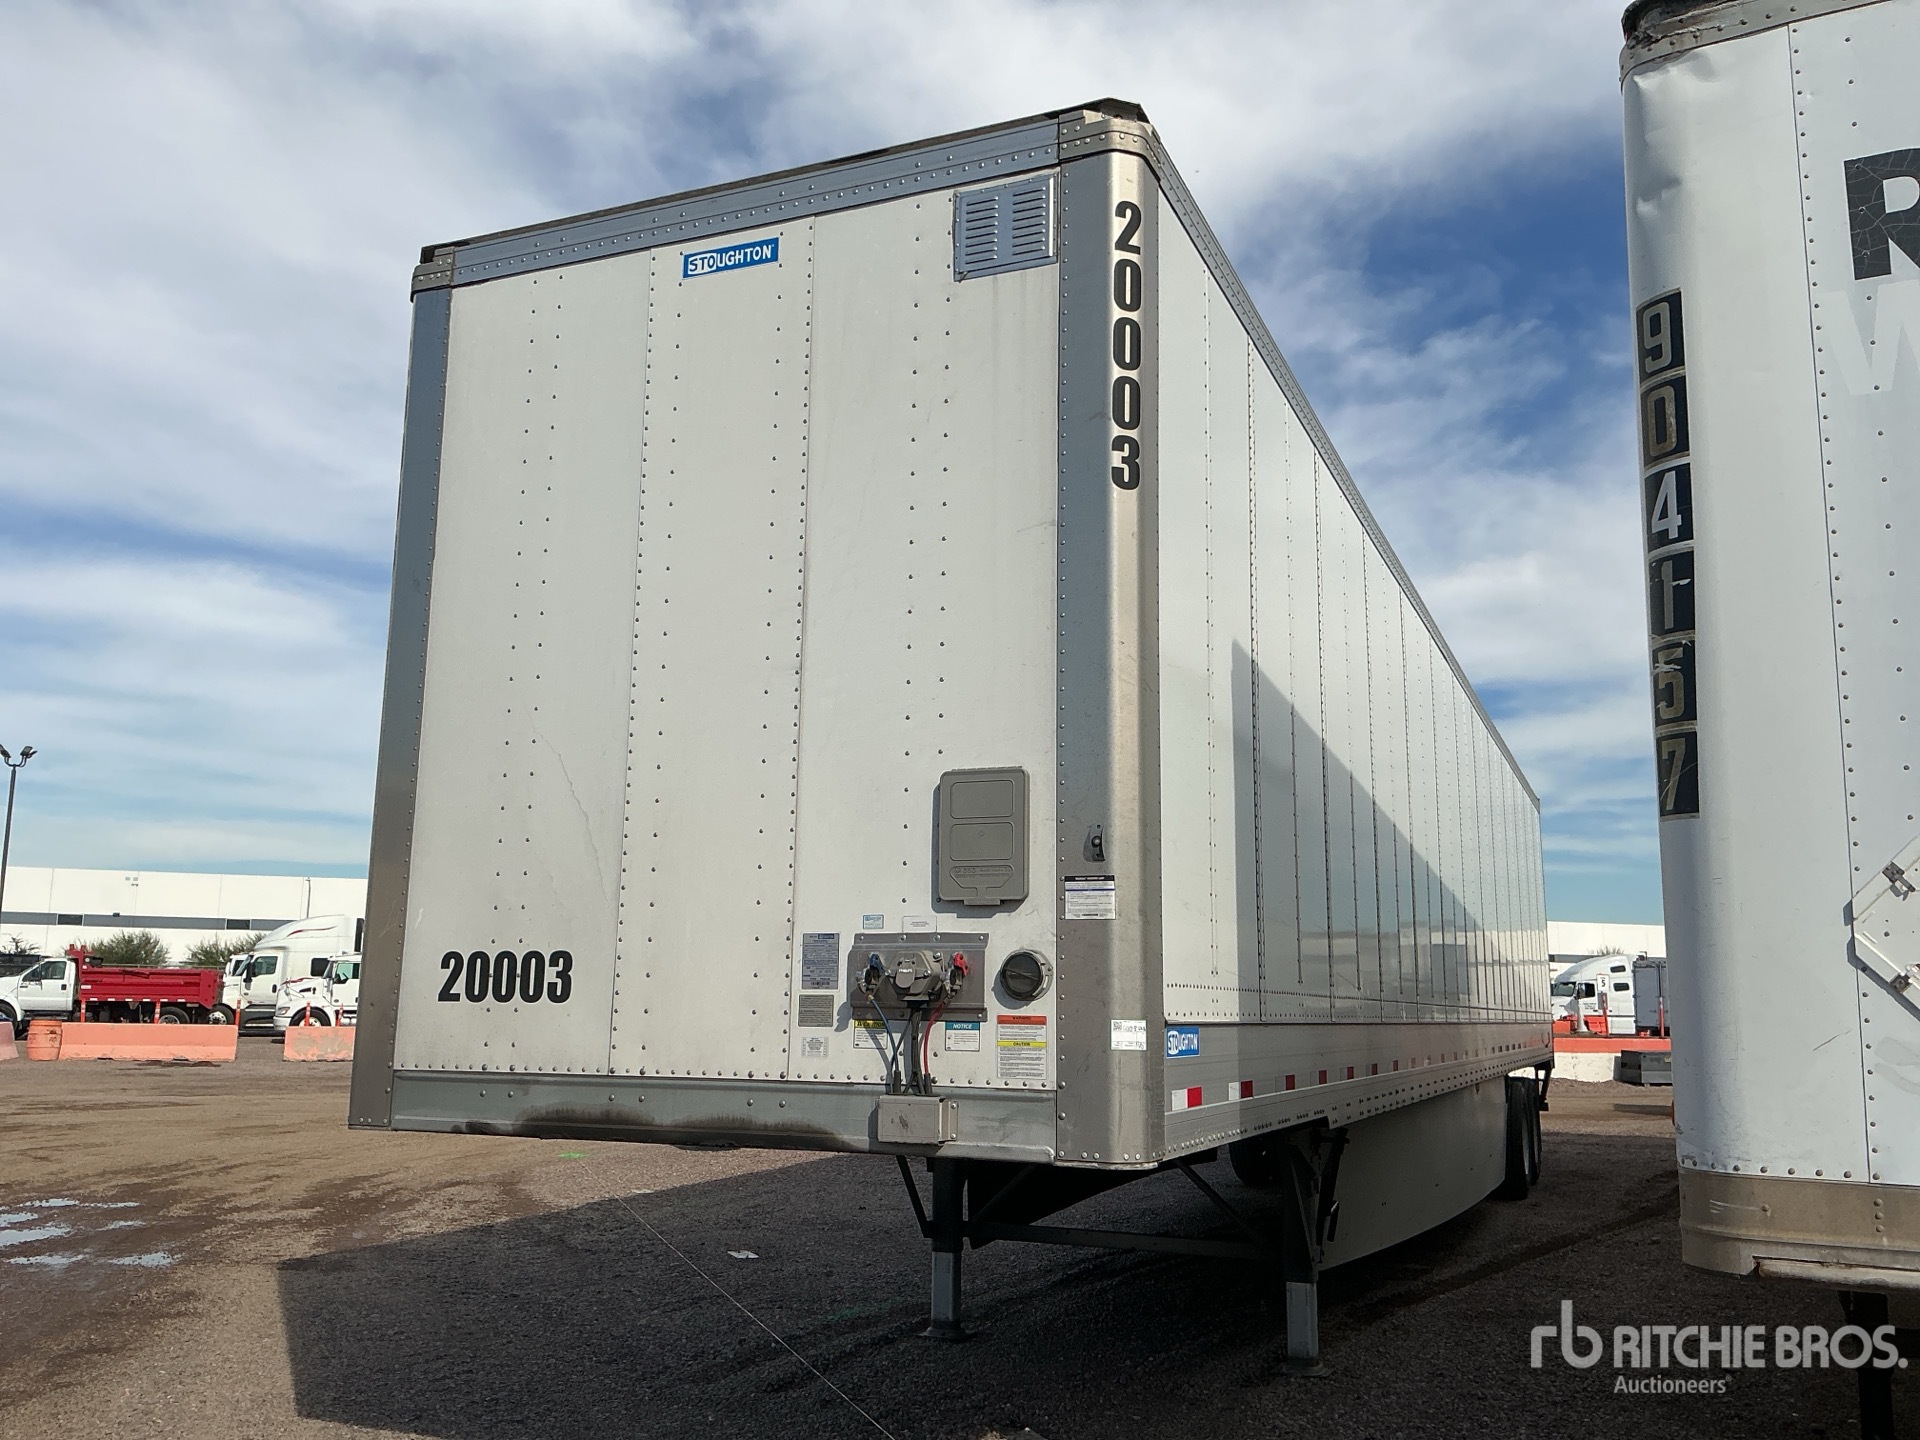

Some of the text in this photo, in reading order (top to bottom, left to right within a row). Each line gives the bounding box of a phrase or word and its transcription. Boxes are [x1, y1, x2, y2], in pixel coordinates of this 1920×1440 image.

[688, 244, 773, 273] STOUGHTON
[1111, 200, 1142, 490] 20003
[1642, 300, 1686, 812] 904157
[437, 950, 573, 1004] 20003
[1601, 979, 1605, 987] 5
[1167, 1032, 1198, 1052] STOUGHTON
